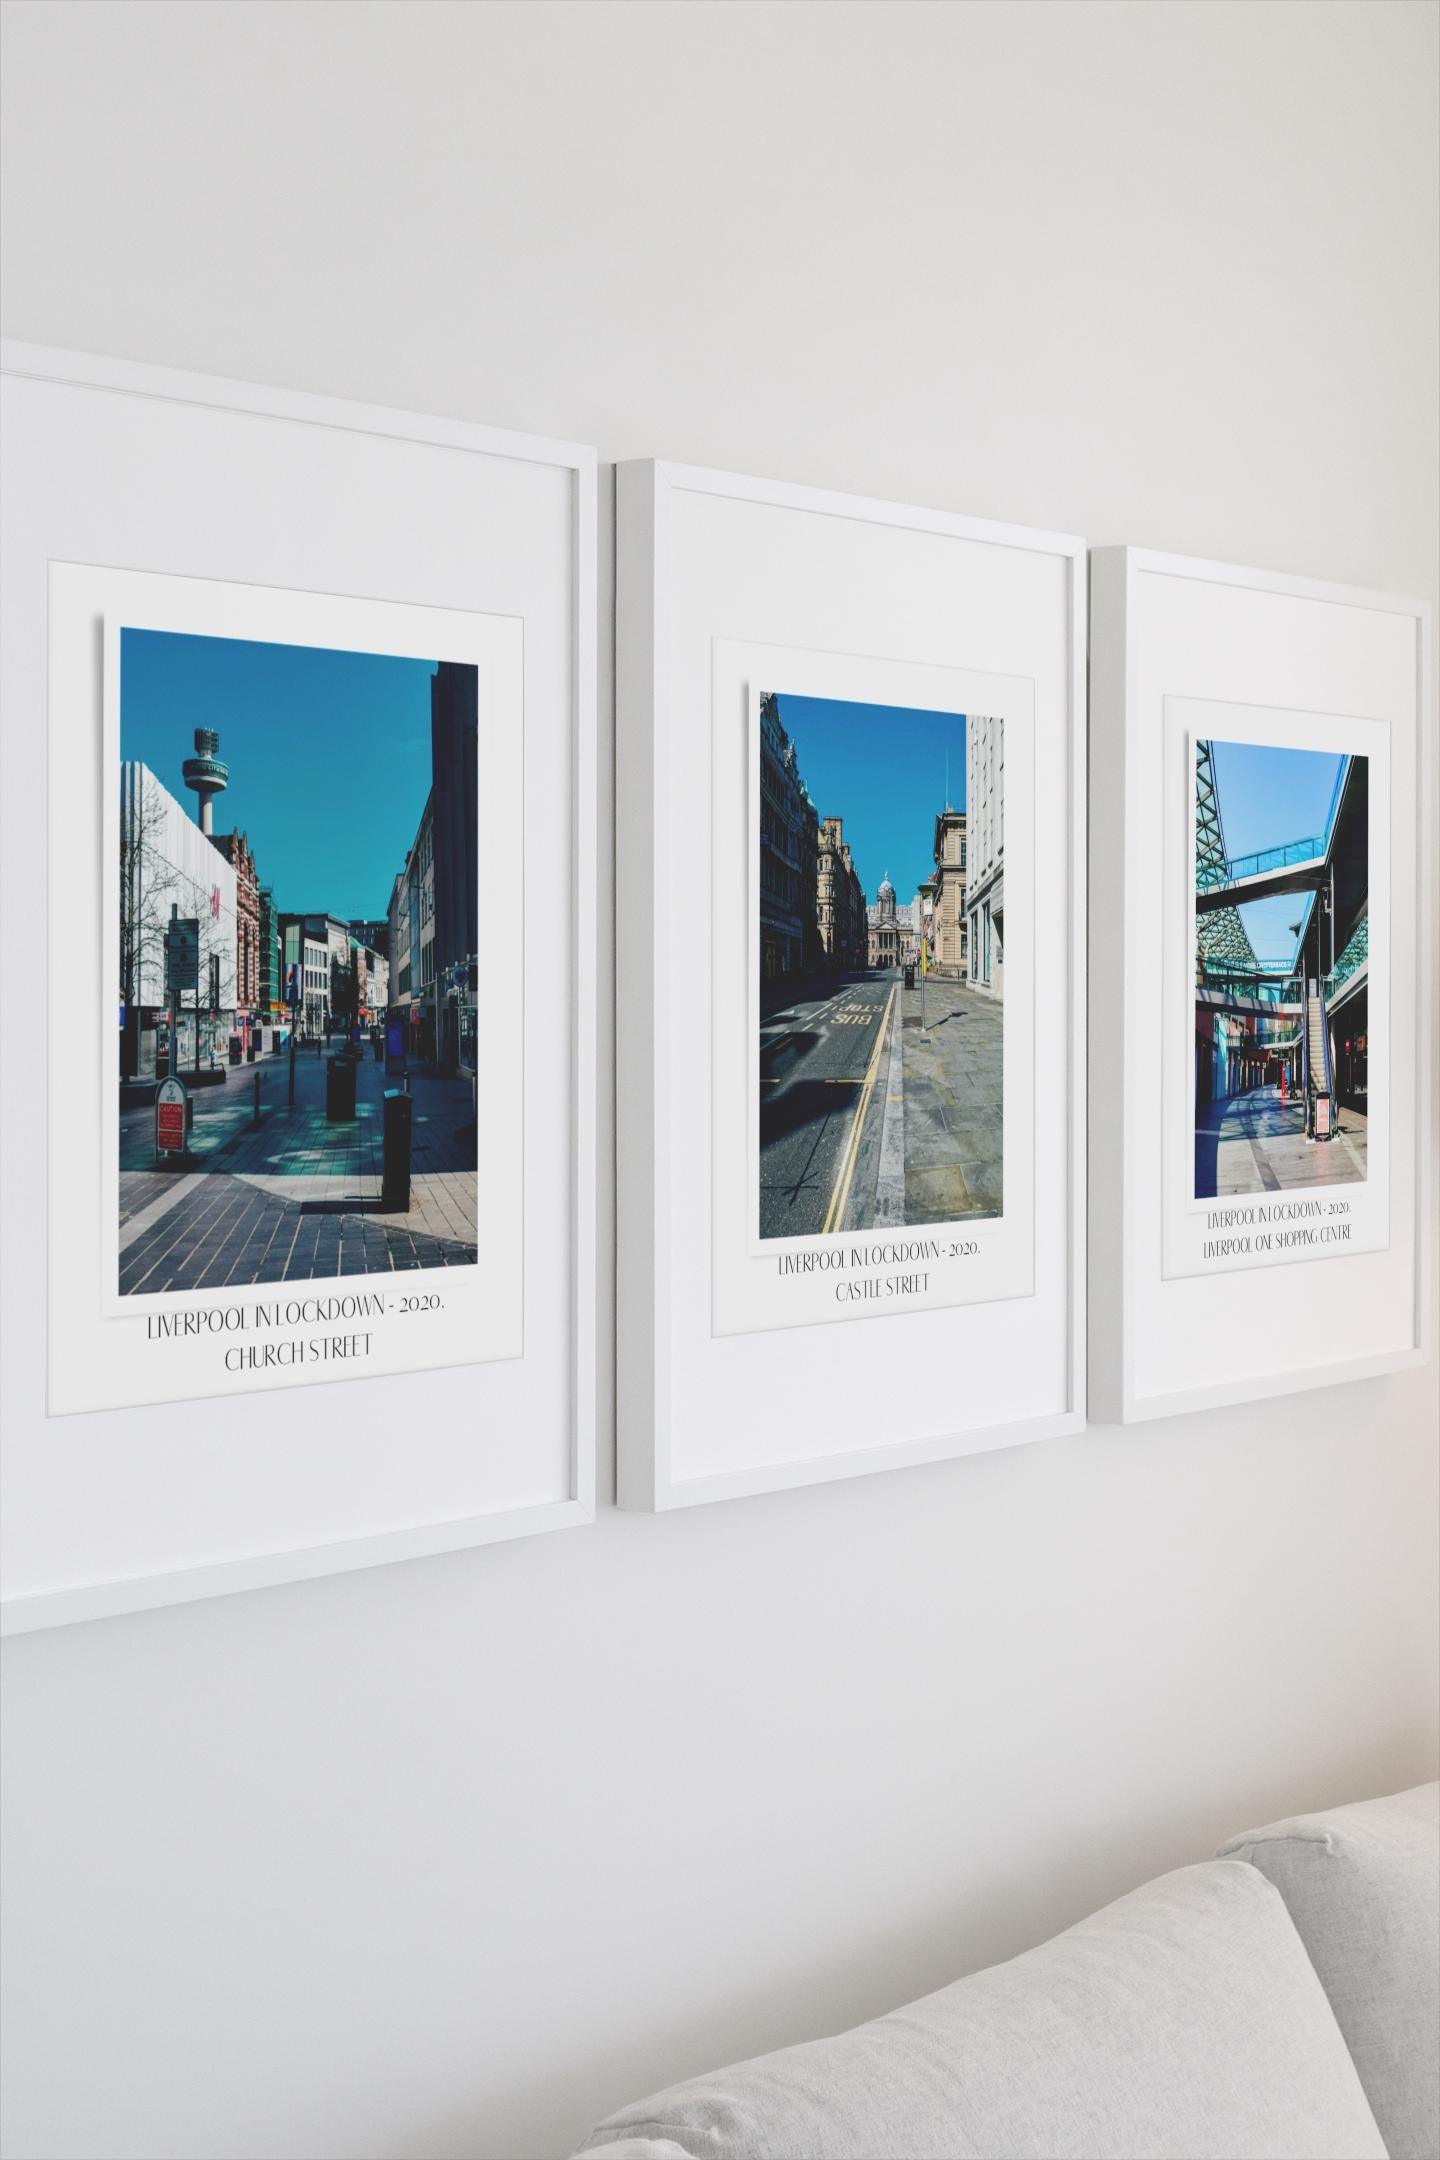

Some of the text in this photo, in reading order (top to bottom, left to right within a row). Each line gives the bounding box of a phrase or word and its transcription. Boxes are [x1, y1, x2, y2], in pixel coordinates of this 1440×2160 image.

[831, 1014, 872, 1024] BUS
[838, 1004, 884, 1012] STOP
[160, 1105, 182, 1113] CAUTION
[1208, 1209, 1255, 1229] LIVERPOOL
[1259, 1208, 1267, 1223] IN
[1269, 1201, 1321, 1222] LOCKDOWN
[1329, 1202, 1351, 1215] 2020.
[1204, 1224, 1351, 1258] LIVERPOOL ONE SHOPPING CENTRE
[779, 1249, 848, 1275] LIVERPOOL
[851, 1248, 863, 1267] IN
[865, 1240, 939, 1266] LOCKDOWN
[949, 1242, 980, 1256] 2020.
[836, 1273, 929, 1301] CASTLE STREET
[148, 1307, 250, 1339] LIVERPOOL
[256, 1305, 272, 1328] IN
[276, 1294, 384, 1326] LOCKDOWN
[399, 1295, 444, 1312] 2020.
[225, 1333, 373, 1371] CHURCH STREET
